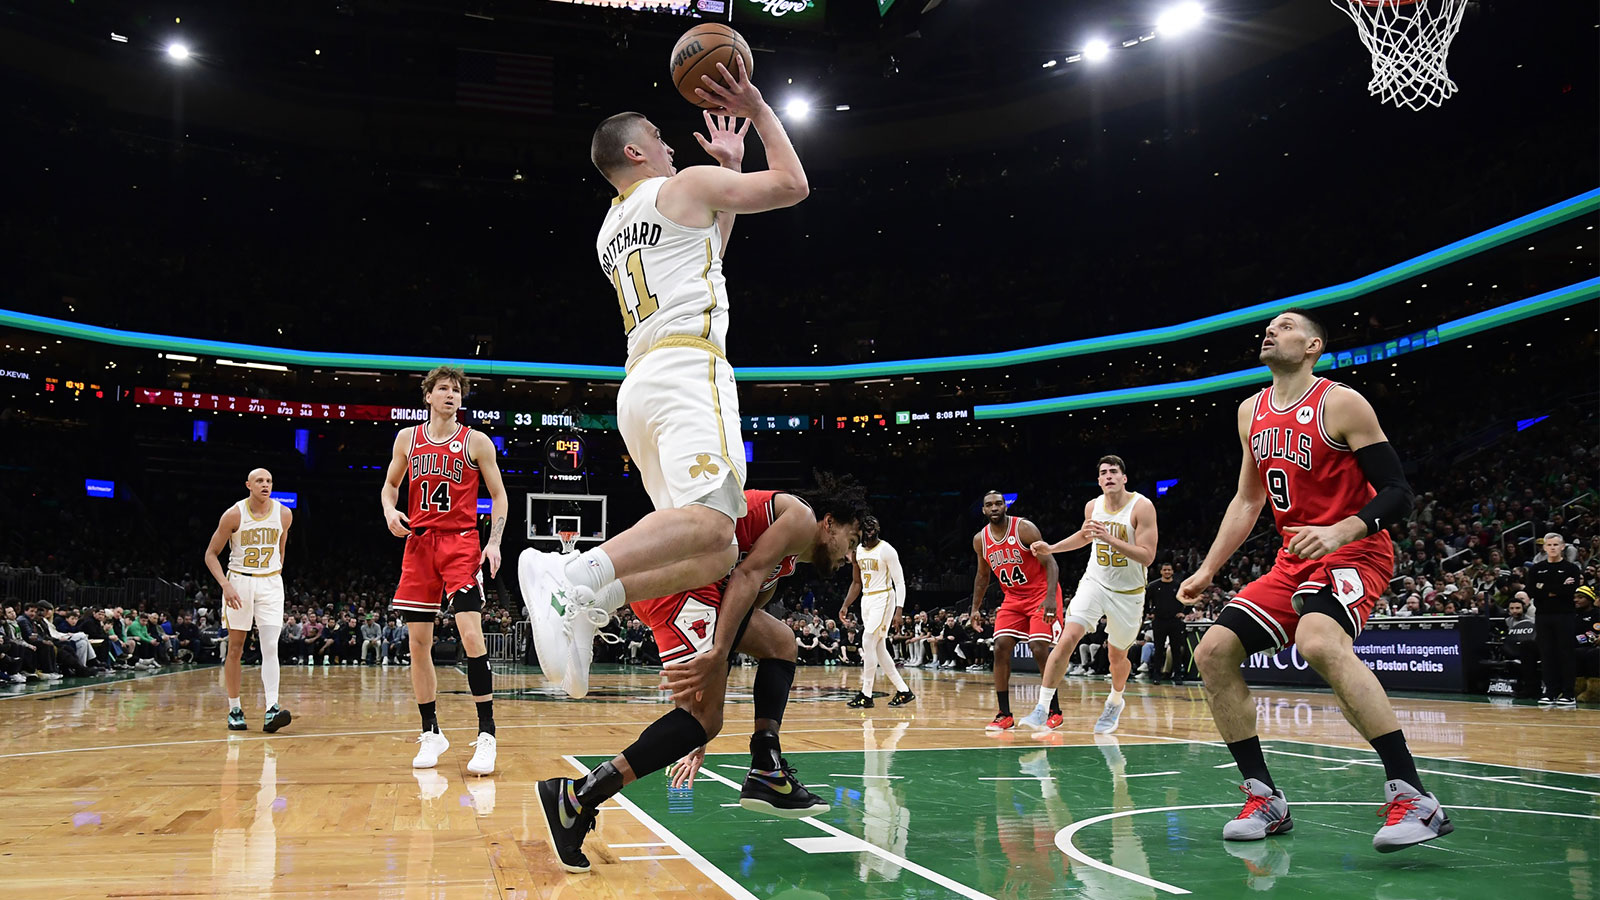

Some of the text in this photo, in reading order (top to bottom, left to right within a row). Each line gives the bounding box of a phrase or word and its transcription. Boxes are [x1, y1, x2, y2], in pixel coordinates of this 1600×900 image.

[612, 248, 660, 336] 11
[248, 404, 265, 412] 2/13
[277, 407, 293, 415] 8/23
[391, 408, 429, 420] CHICAGO
[472, 410, 501, 419] 10:43
[911, 412, 930, 420] Bank
[936, 411, 954, 420] 8:08
[954, 410, 968, 418] PM
[514, 413, 533, 425] 33
[556, 440, 580, 451] 10:43
[1251, 427, 1312, 471] BULLS
[566, 450, 578, 469] 7
[411, 453, 464, 484] BULLS
[420, 480, 451, 512] 14
[1266, 468, 1292, 512] 9
[240, 528, 279, 546] BOSTON
[243, 547, 275, 568] 27
[988, 548, 1024, 572] BULLS
[1096, 543, 1129, 568] 52
[863, 573, 872, 589] 7
[999, 564, 1028, 588] 44
[1508, 627, 1534, 635] PIMCO
[1013, 643, 1034, 658] PIM
[1353, 643, 1460, 657] nvestment Management
[1376, 660, 1408, 671] Boston
[1409, 660, 1444, 672] Celtics
